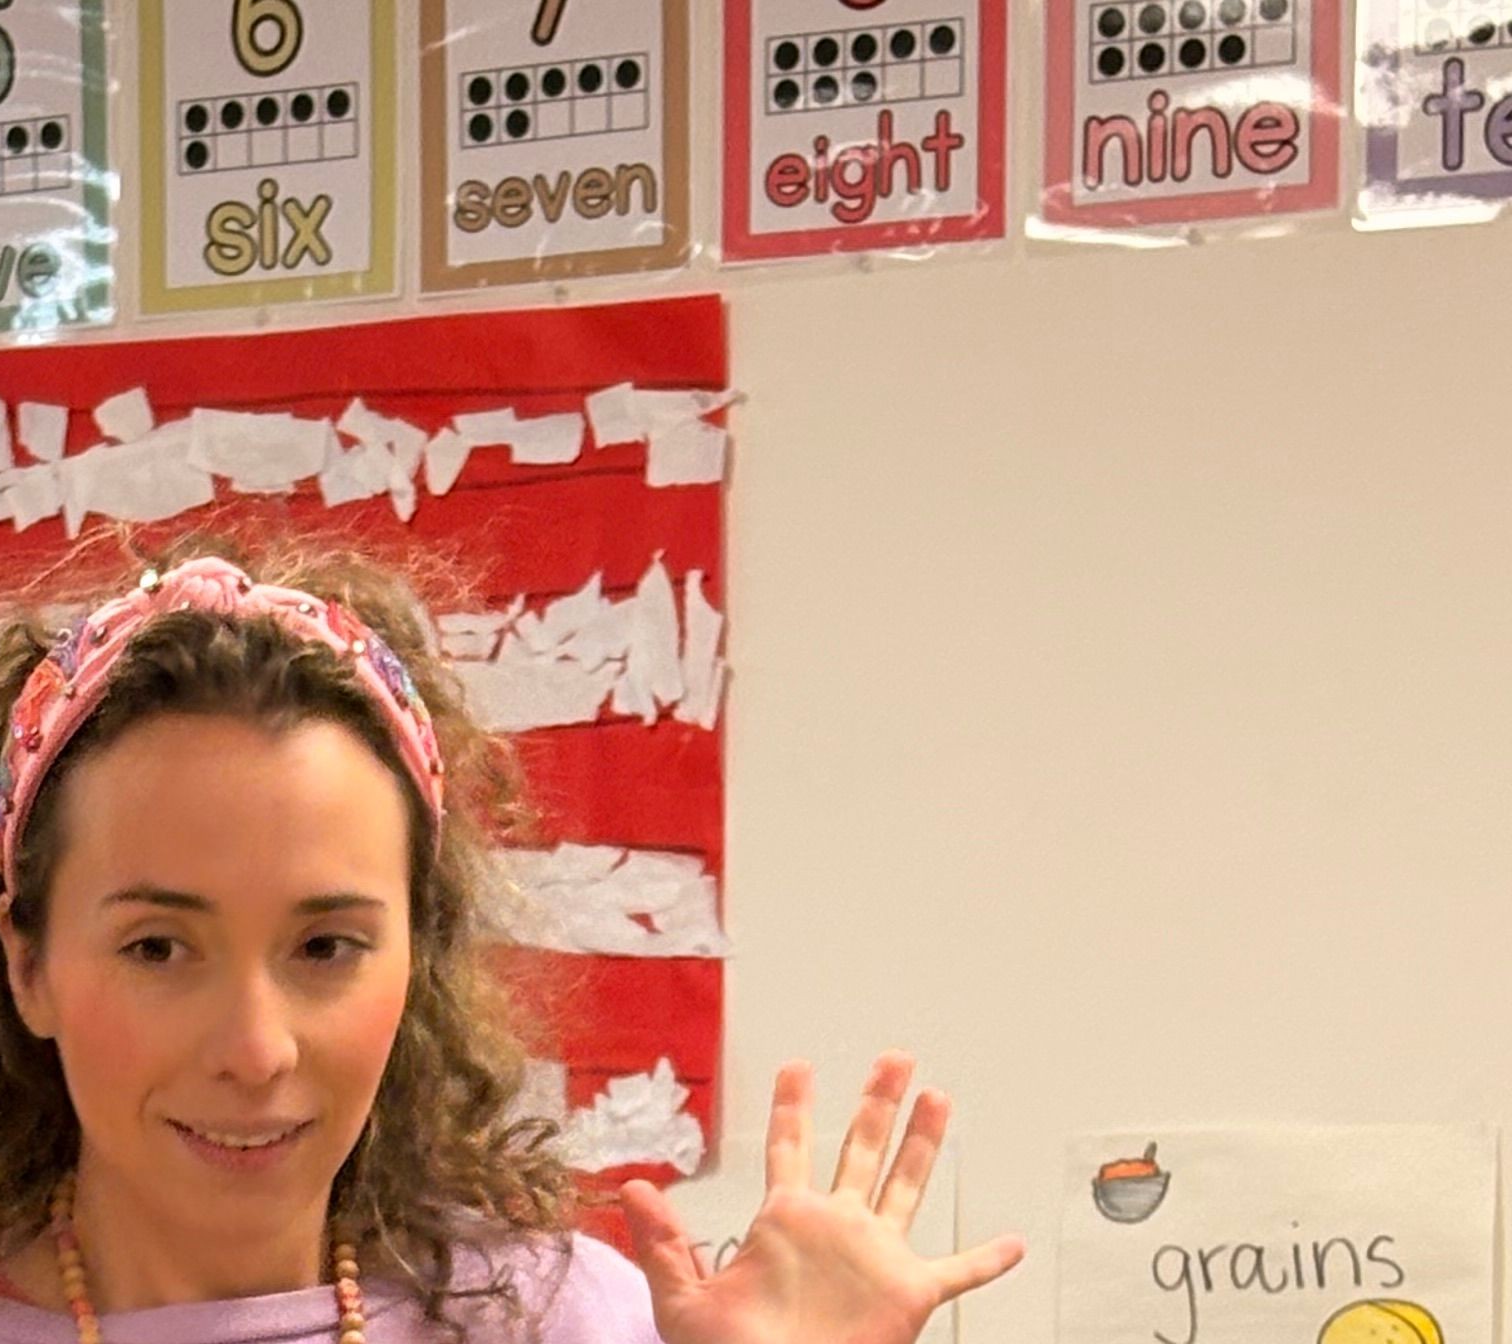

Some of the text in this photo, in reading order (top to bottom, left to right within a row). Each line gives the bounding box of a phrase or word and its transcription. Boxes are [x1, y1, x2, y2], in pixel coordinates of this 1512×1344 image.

[232, 0, 304, 76] 6
[765, 111, 964, 224] eight
[1082, 89, 1301, 191] nine
[204, 179, 332, 276] six
[454, 156, 656, 234] seven
